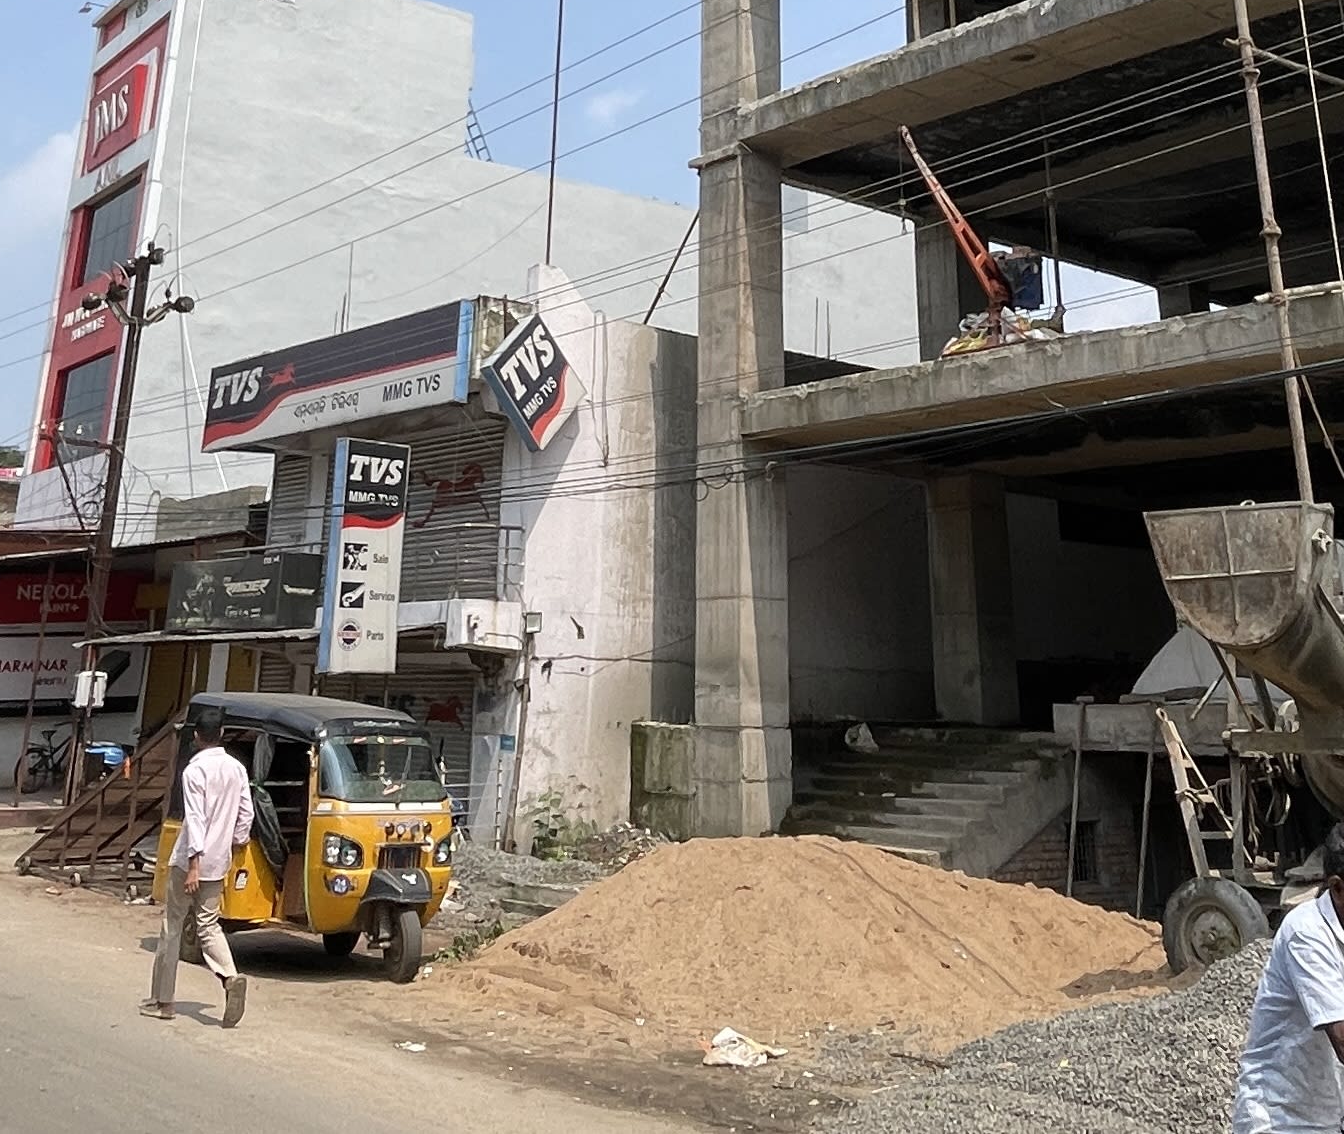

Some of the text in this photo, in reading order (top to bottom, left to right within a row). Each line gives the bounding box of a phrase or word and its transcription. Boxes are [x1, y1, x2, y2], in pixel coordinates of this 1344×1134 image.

[499, 323, 555, 401] TVS
[212, 366, 263, 410] TVS
[382, 374, 441, 403] MMG TVS
[522, 376, 558, 420] MMG TVS
[349, 454, 404, 486] TVS
[348, 490, 399, 507] MMG TVS
[16, 583, 90, 601] NEROLA
[366, 629, 384, 641] Parts
